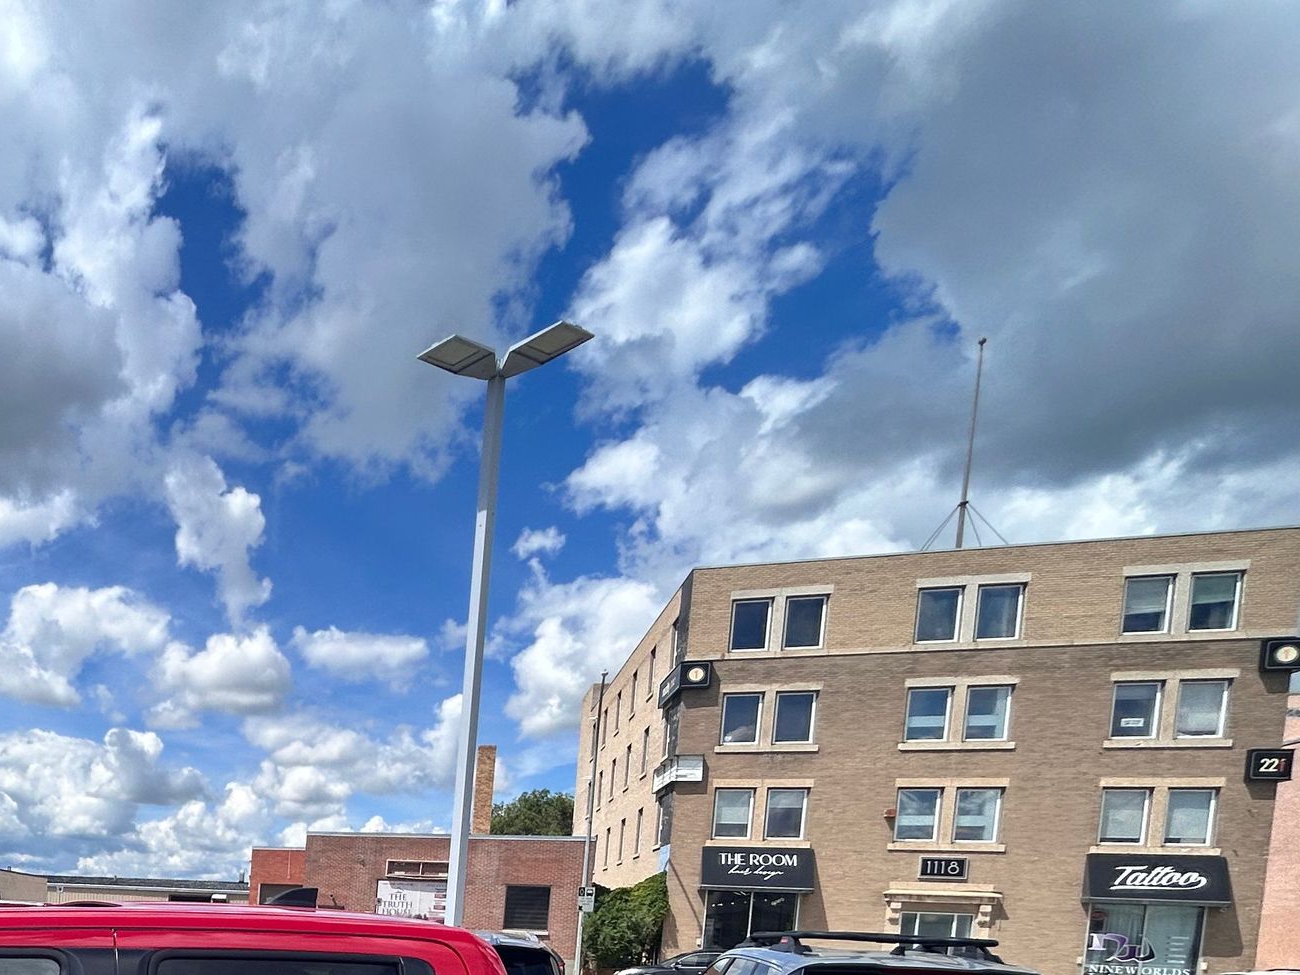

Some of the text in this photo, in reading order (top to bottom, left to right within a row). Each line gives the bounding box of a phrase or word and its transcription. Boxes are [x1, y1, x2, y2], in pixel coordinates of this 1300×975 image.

[719, 853, 798, 867] THE ROOM
[926, 860, 960, 875] 1118
[1109, 866, 1207, 890] Tattoo
[390, 893, 407, 901] THE
[382, 900, 413, 909] TRUTH
[1088, 964, 1123, 974] NINE
